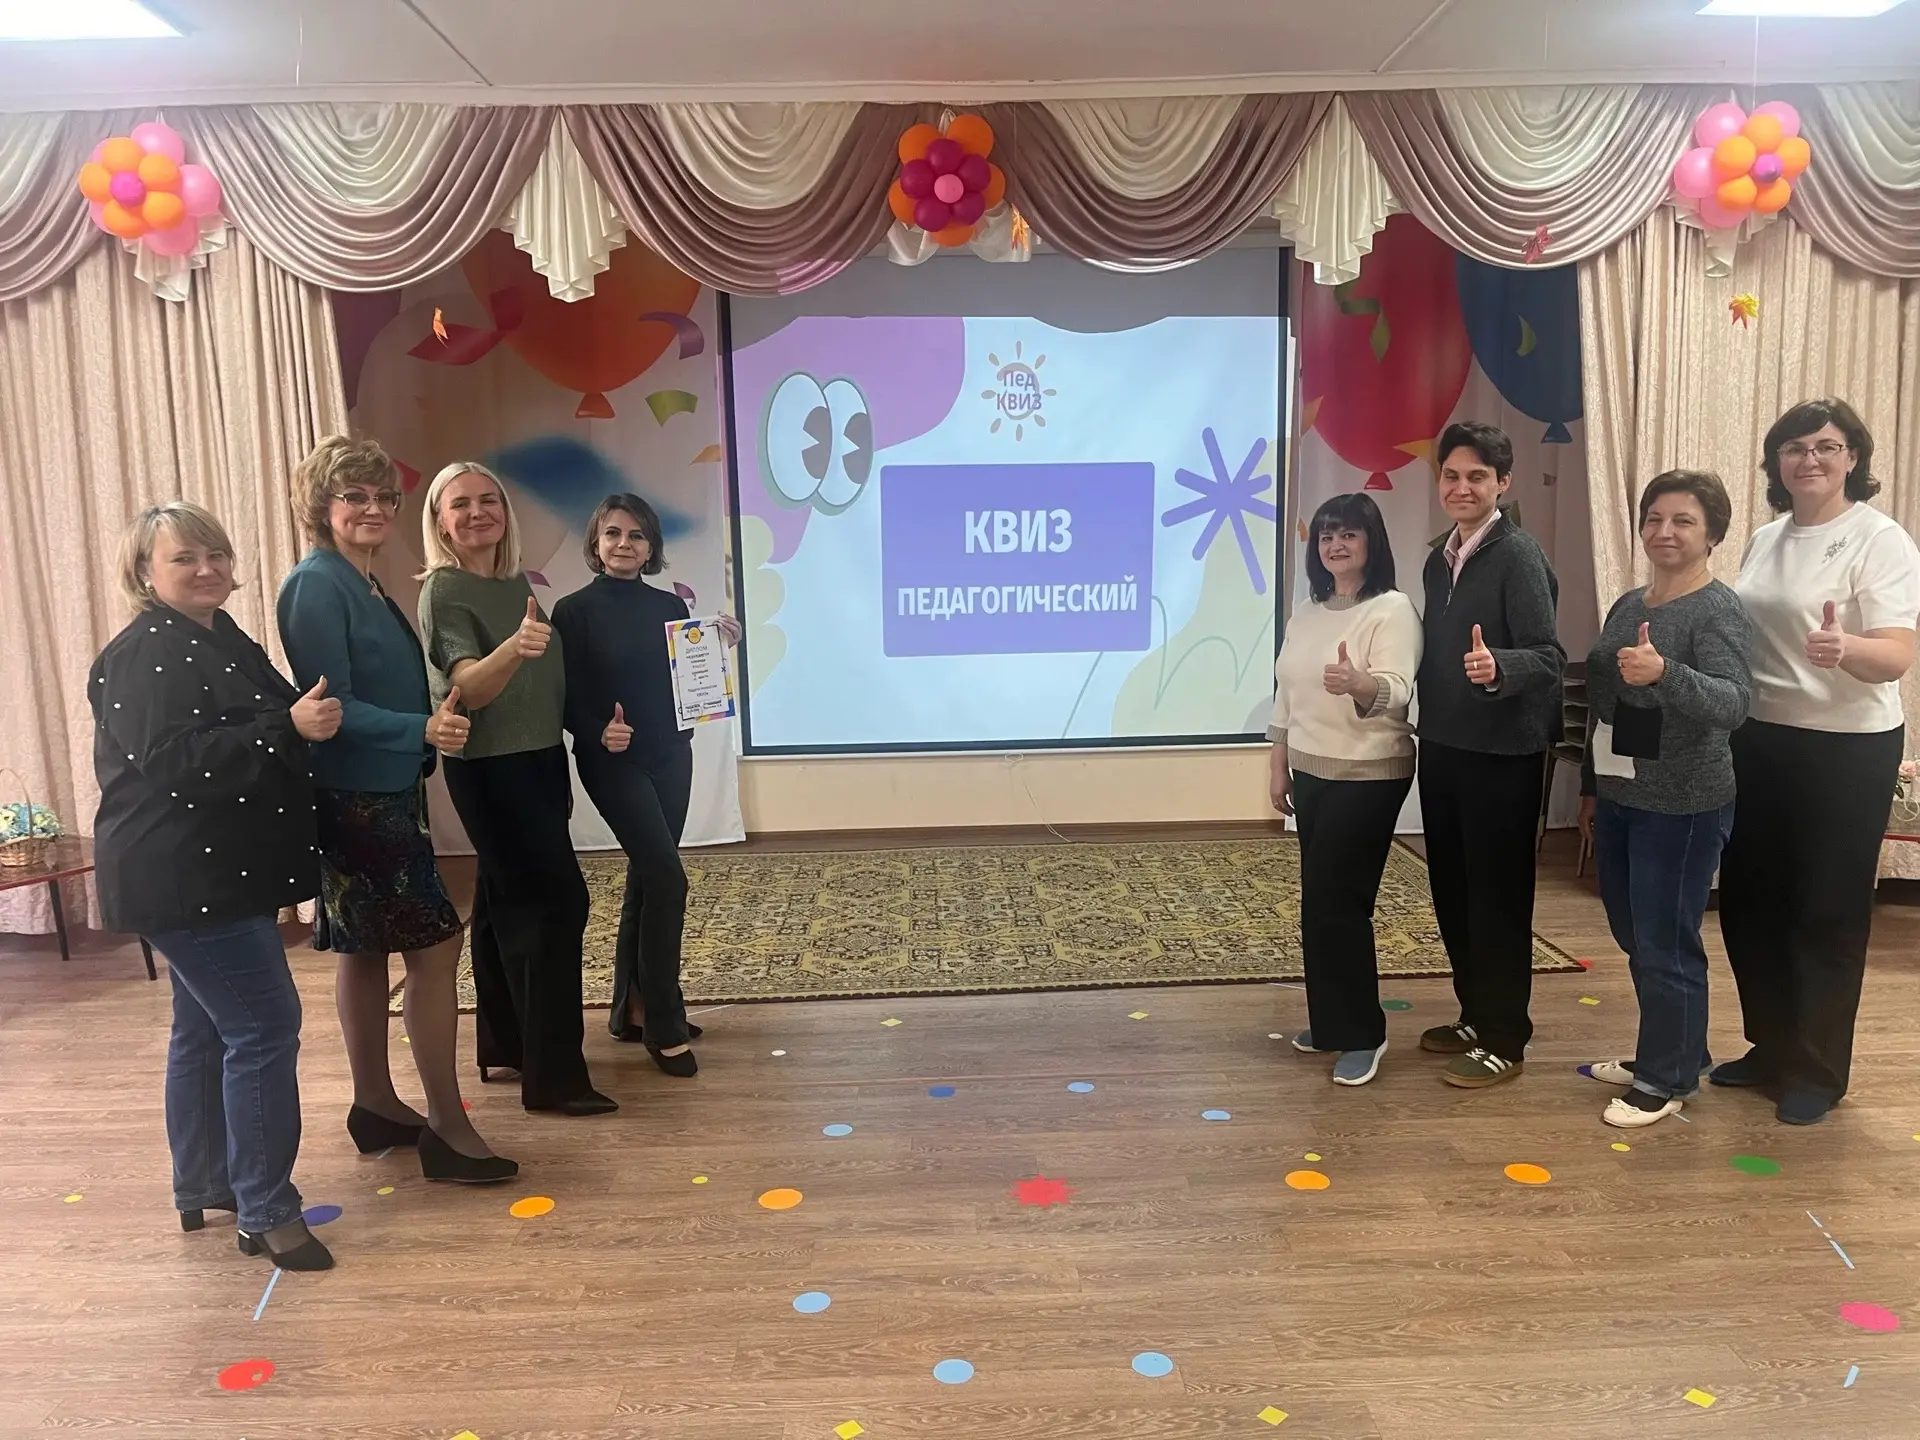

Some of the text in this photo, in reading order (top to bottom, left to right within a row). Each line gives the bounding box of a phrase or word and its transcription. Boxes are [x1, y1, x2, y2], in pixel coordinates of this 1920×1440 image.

[1003, 371, 1036, 391] Пед
[996, 391, 1042, 411] КВИЗ
[964, 508, 1073, 554] КВИЗ
[897, 574, 1138, 621] ПЕДАГОГИЧЕСКИЙ
